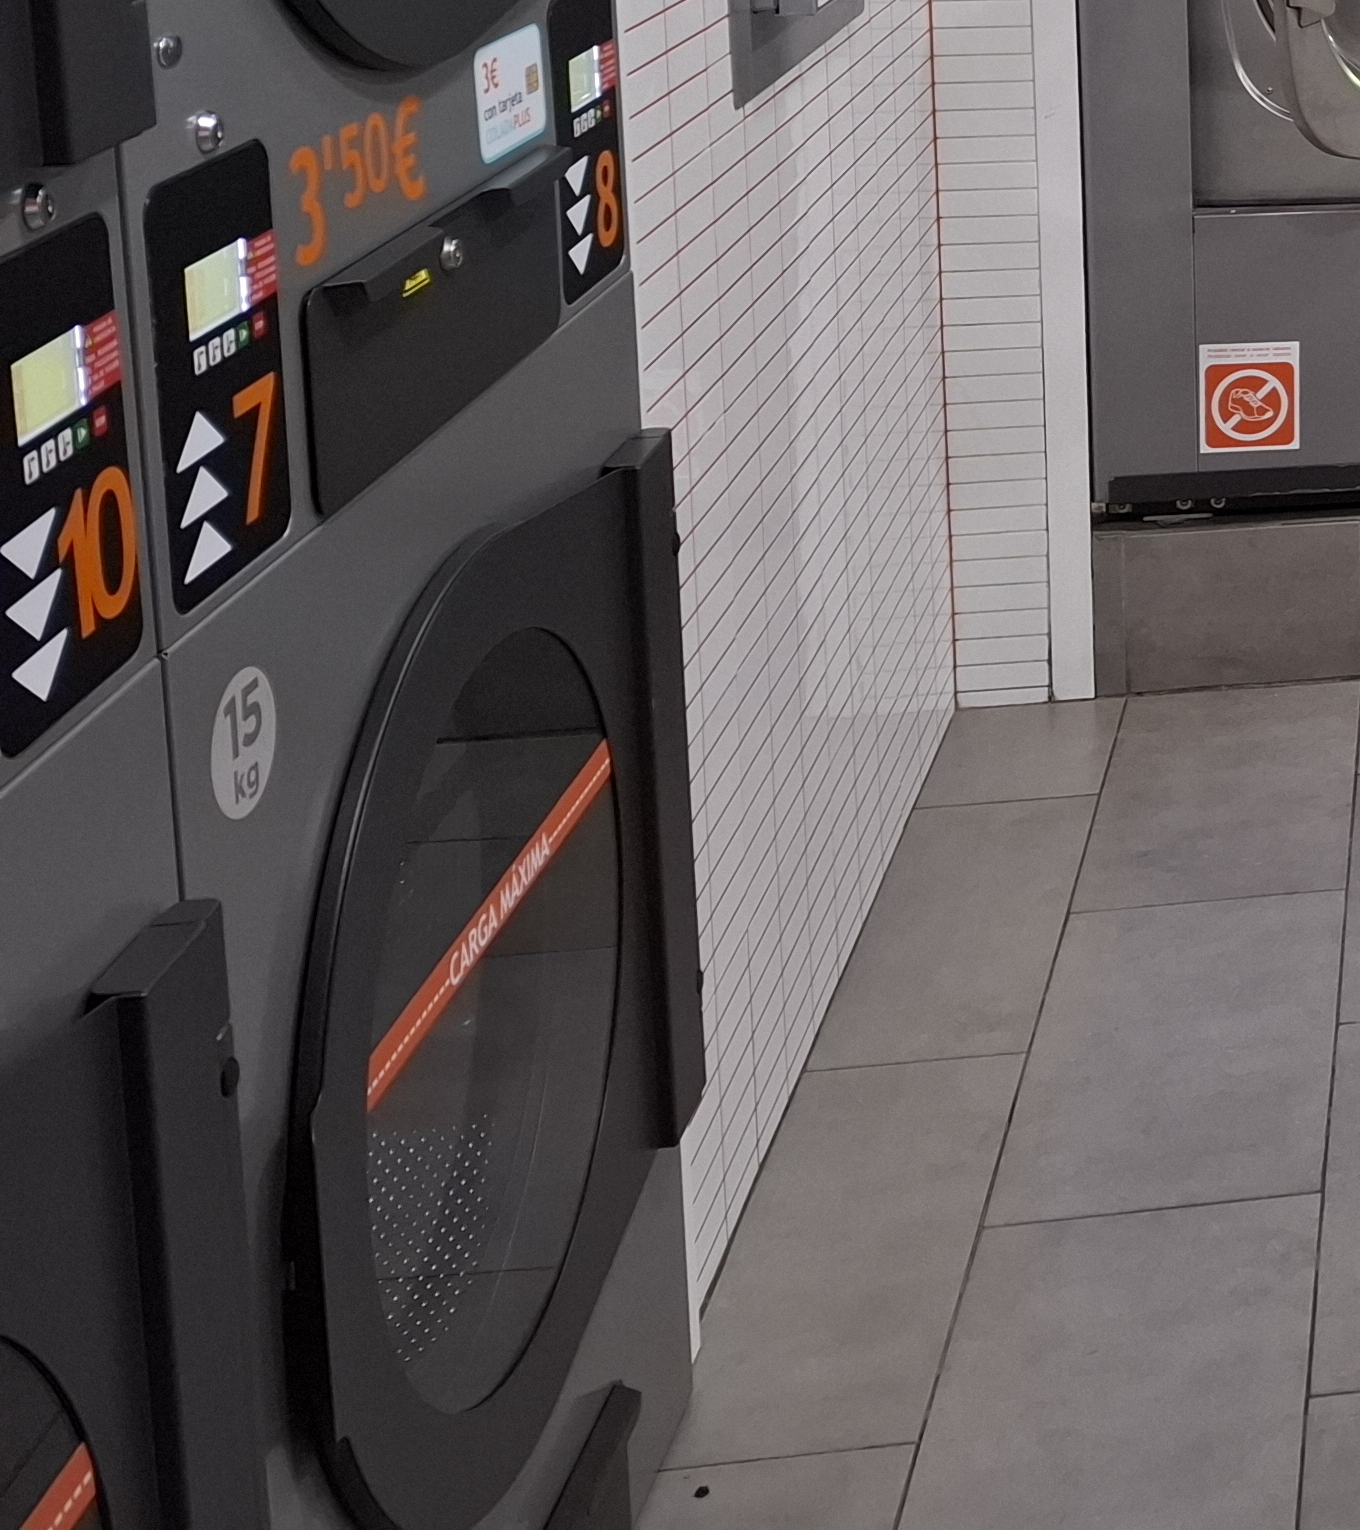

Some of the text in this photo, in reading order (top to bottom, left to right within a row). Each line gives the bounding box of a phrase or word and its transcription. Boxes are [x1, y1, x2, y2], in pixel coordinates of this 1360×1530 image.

[481, 57, 499, 94] 3€
[484, 91, 522, 121] con tarjeta
[290, 96, 427, 265] 3'50€
[595, 150, 620, 247] 8
[232, 371, 275, 526] 7
[58, 466, 138, 640] 10
[223, 676, 262, 761] 15
[233, 761, 261, 805] kg
[449, 832, 551, 986] CARGA MÁXIMA
